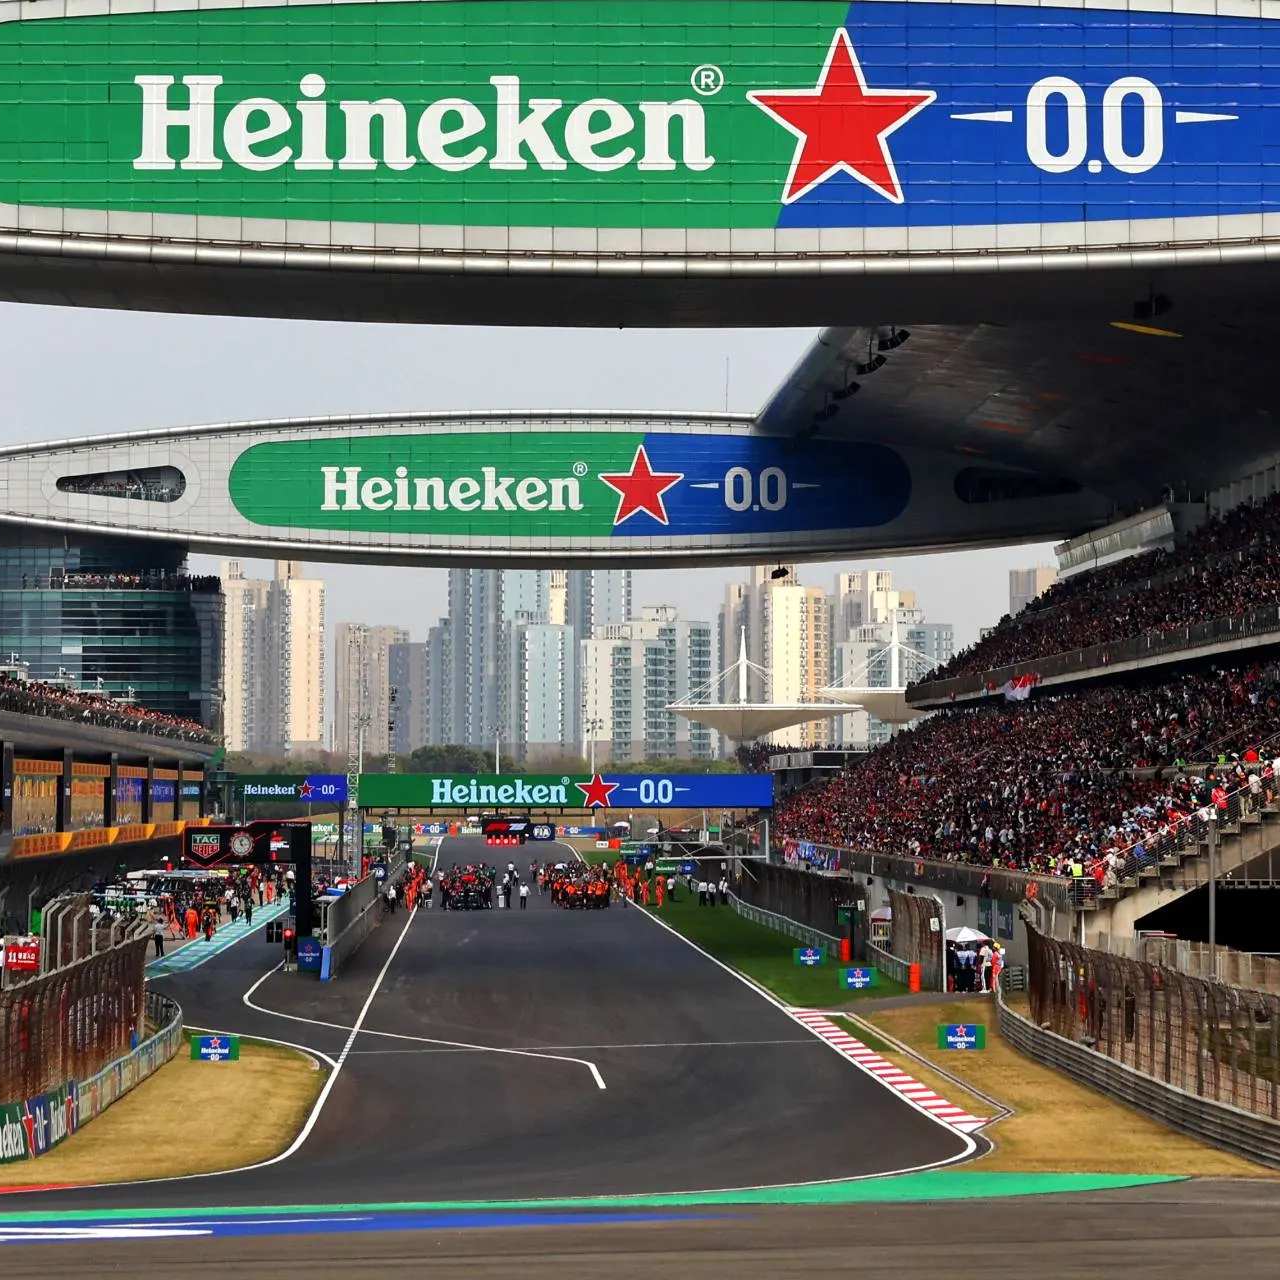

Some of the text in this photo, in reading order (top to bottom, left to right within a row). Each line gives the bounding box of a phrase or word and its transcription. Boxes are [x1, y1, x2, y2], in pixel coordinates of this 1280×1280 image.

[1026, 76, 1163, 173] 0.0
[724, 466, 787, 511] 0.0
[639, 779, 672, 803] 0.0
[195, 835, 217, 844] TAG
[8, 951, 16, 962] 11
